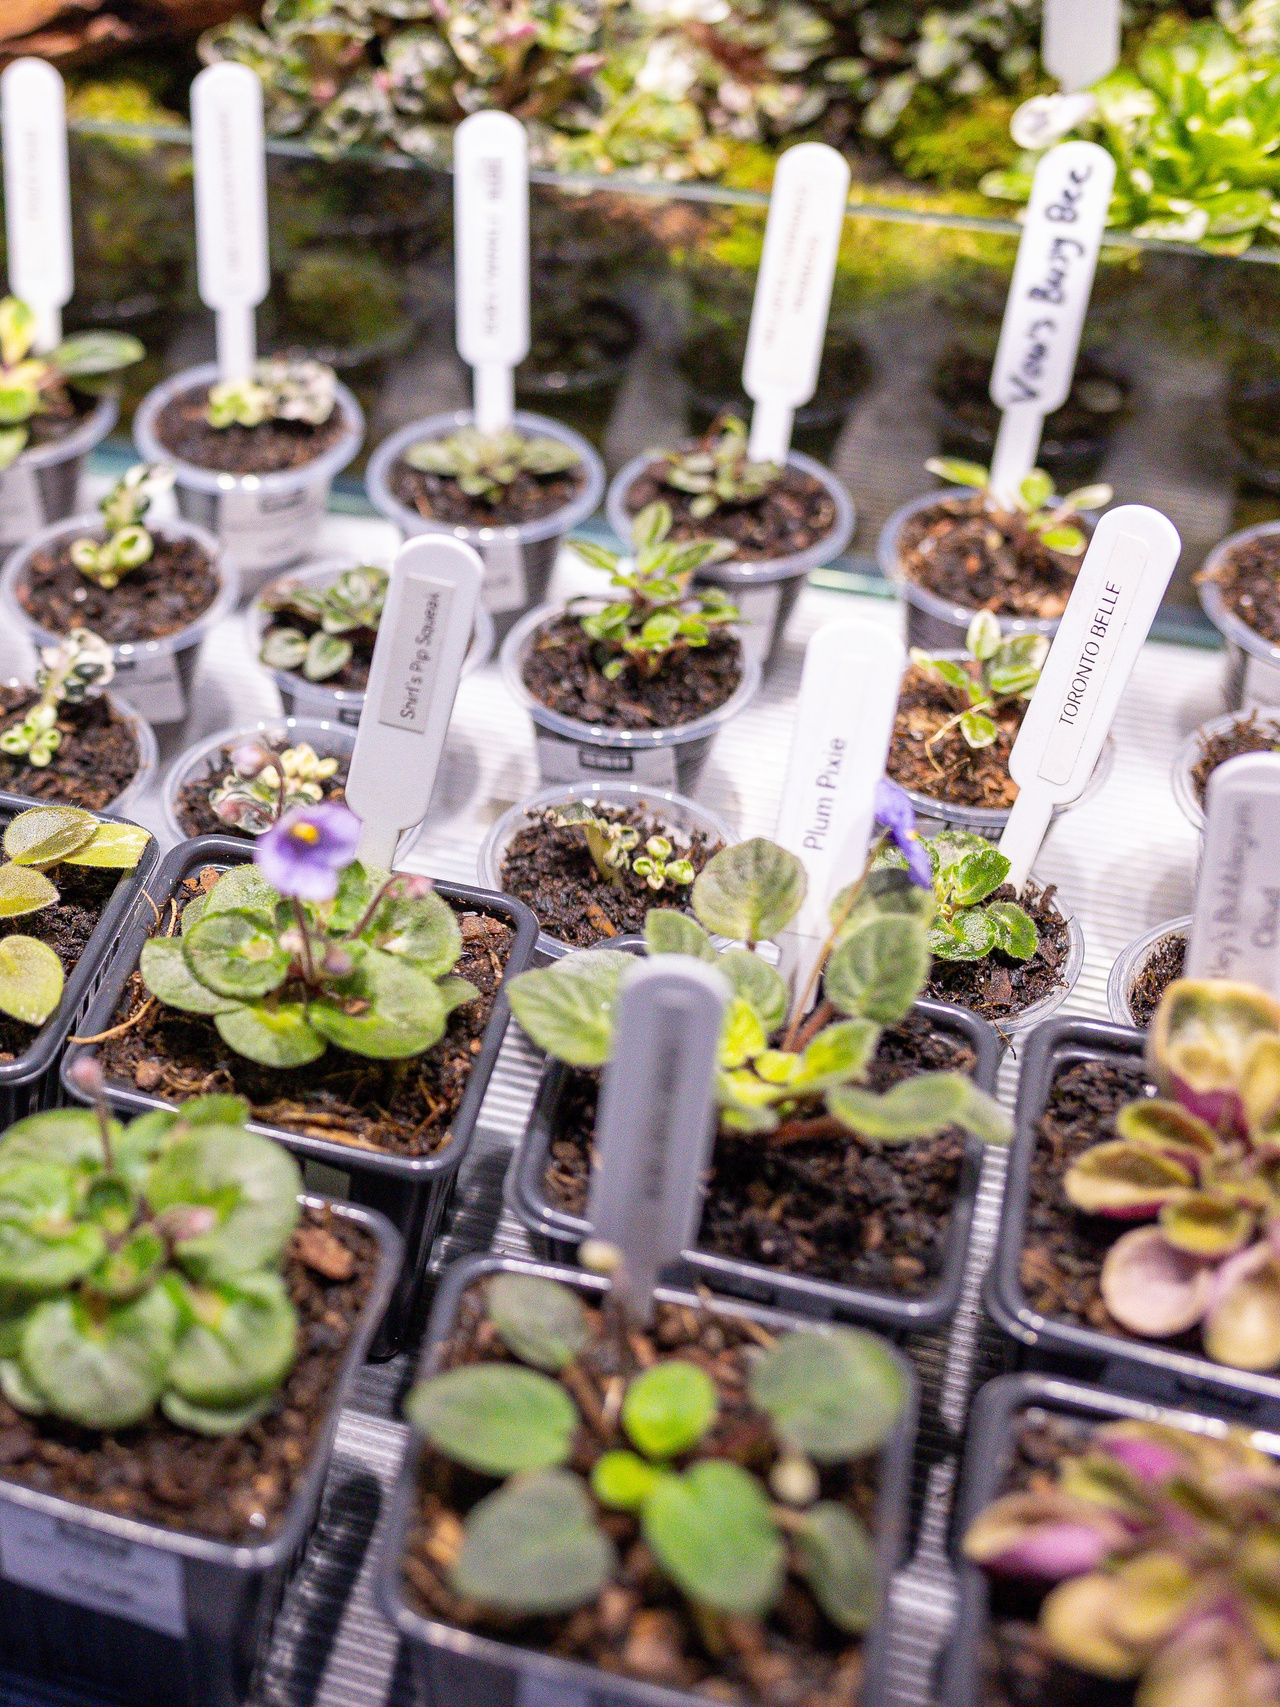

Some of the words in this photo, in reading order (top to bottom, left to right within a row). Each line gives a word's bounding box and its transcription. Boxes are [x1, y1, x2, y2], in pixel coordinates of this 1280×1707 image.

[408, 648, 431, 674] Pip
[1058, 641, 1100, 725] TORONTO
[1089, 580, 1122, 638] BELLE
[815, 737, 847, 790] Pixie
[802, 797, 835, 851] Plum
